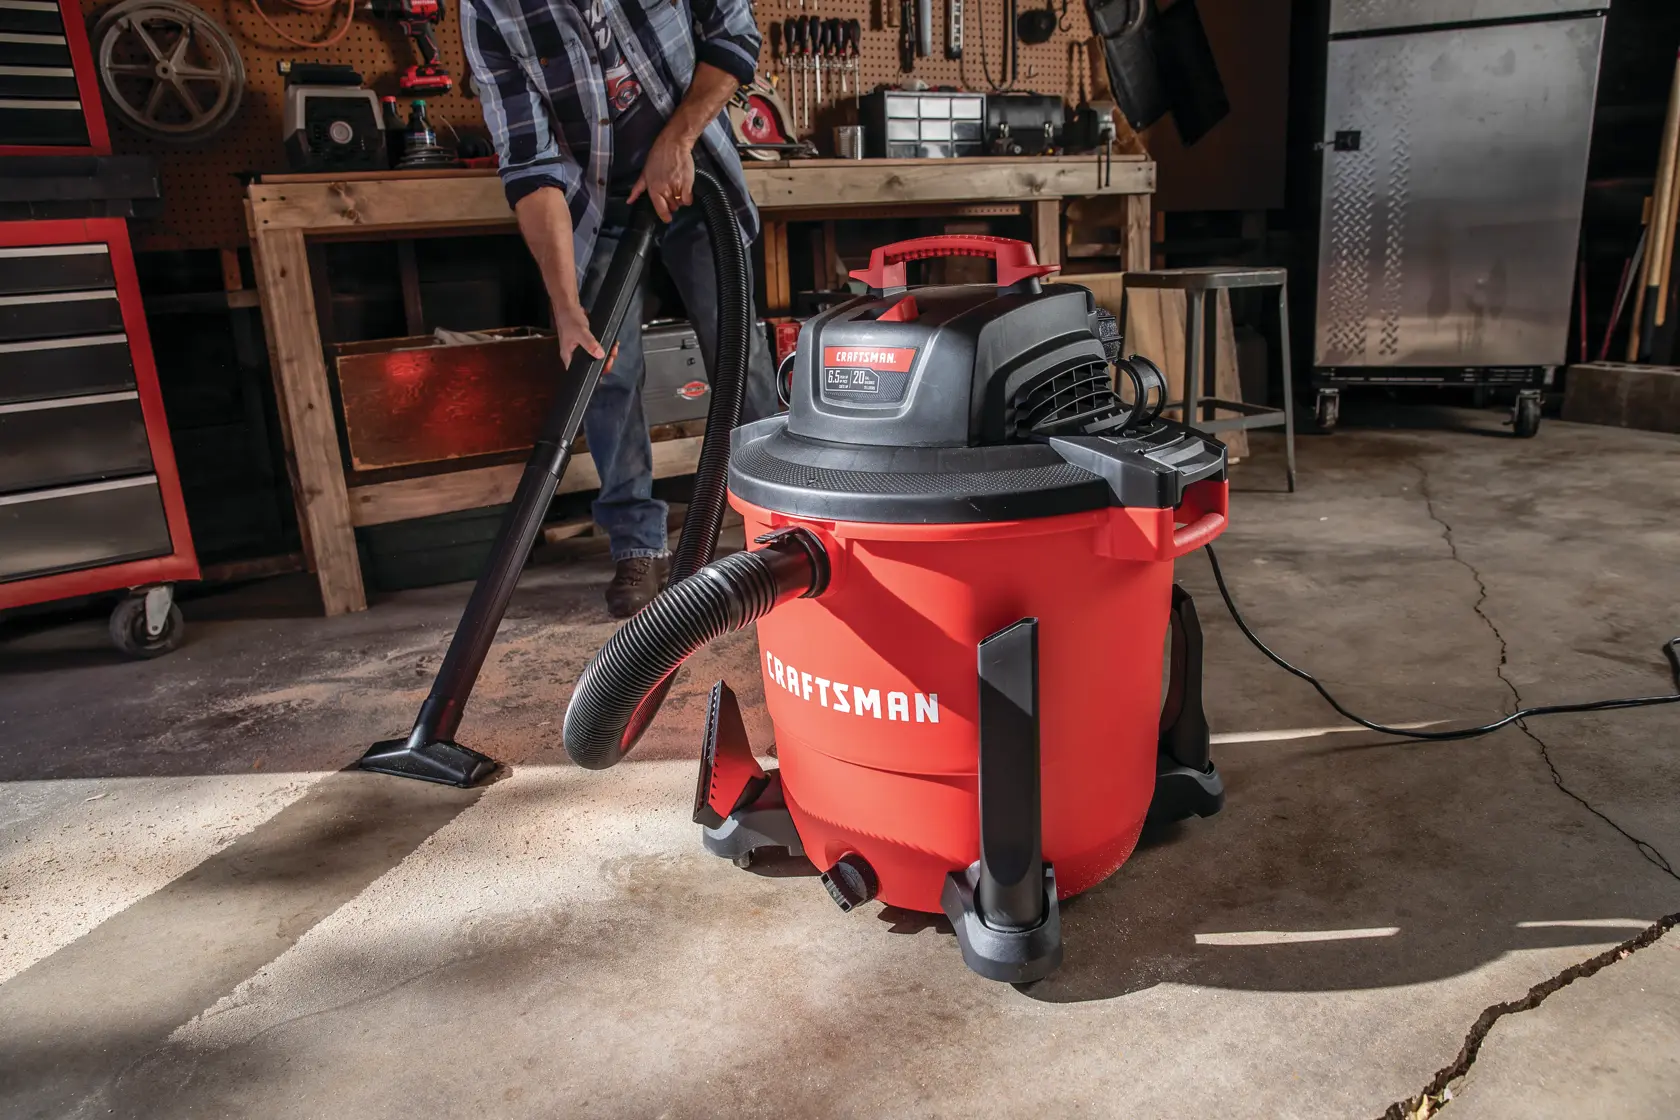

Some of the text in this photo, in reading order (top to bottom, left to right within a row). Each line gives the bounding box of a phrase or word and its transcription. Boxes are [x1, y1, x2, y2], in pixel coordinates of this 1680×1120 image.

[828, 370, 840, 383] 6.5
[853, 370, 865, 384] 20
[766, 650, 939, 723] CRAFTSMAN
